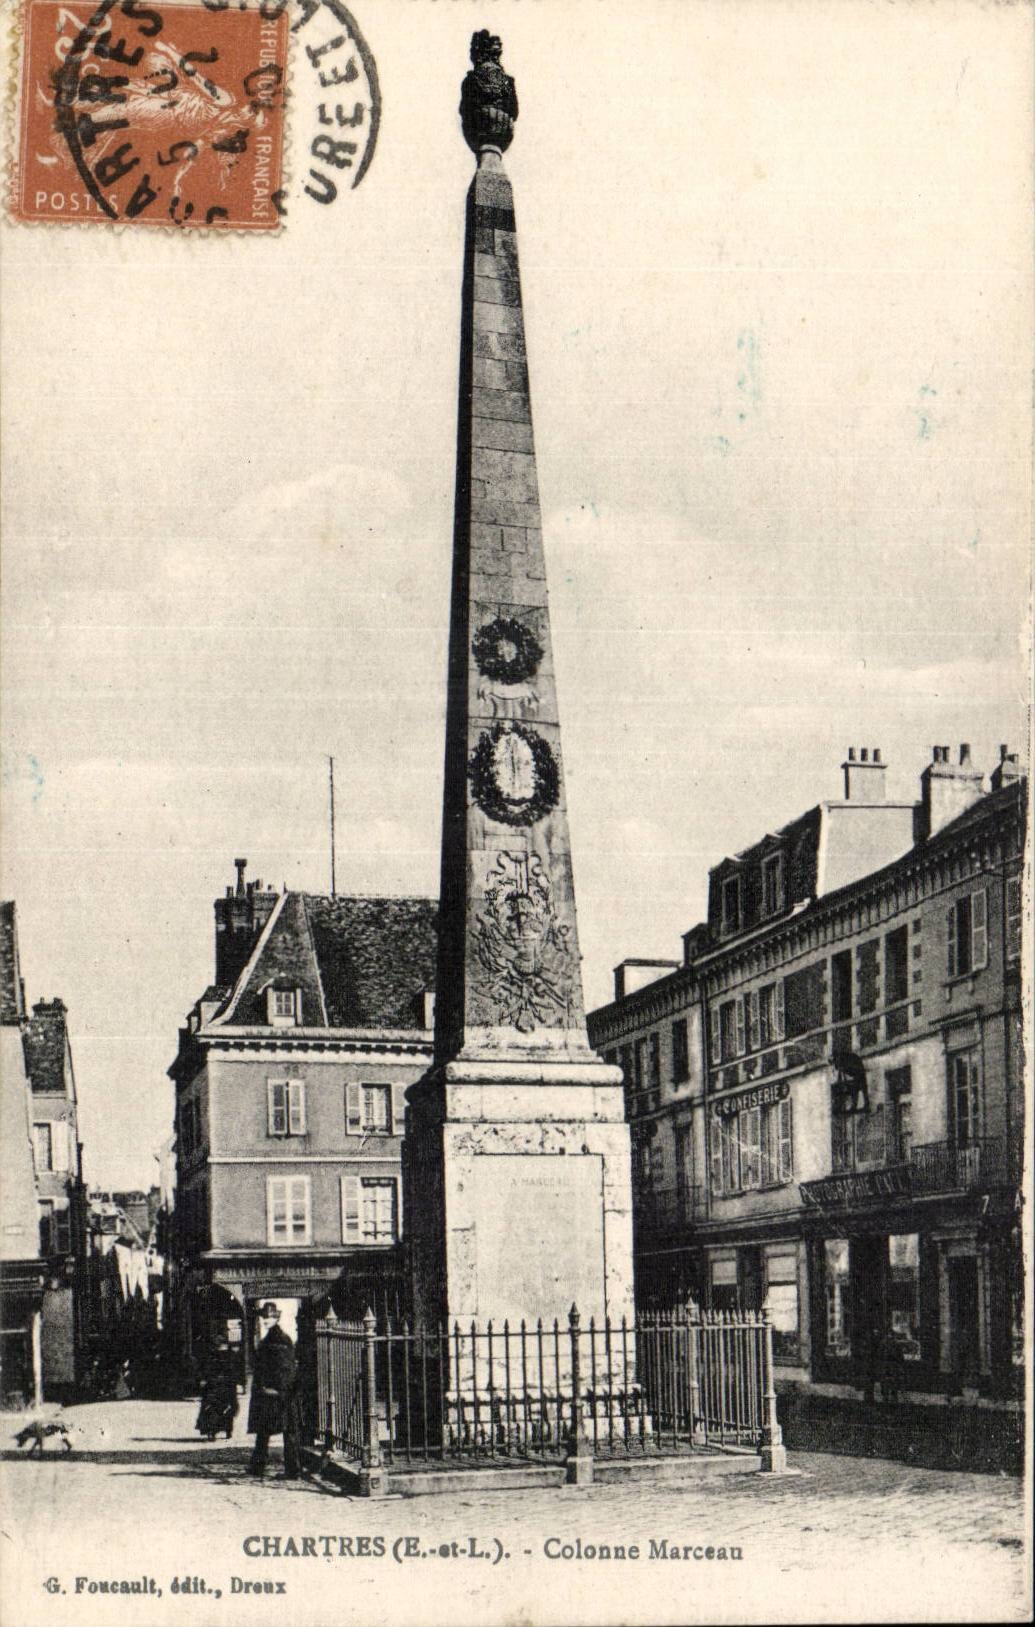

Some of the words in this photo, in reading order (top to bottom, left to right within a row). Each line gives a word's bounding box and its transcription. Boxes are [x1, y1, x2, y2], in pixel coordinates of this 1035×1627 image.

[257, 17, 279, 108] REPUBIQU
[251, 136, 273, 218] FRANÇAISE
[722, 1085, 781, 1114] CONFISERIE
